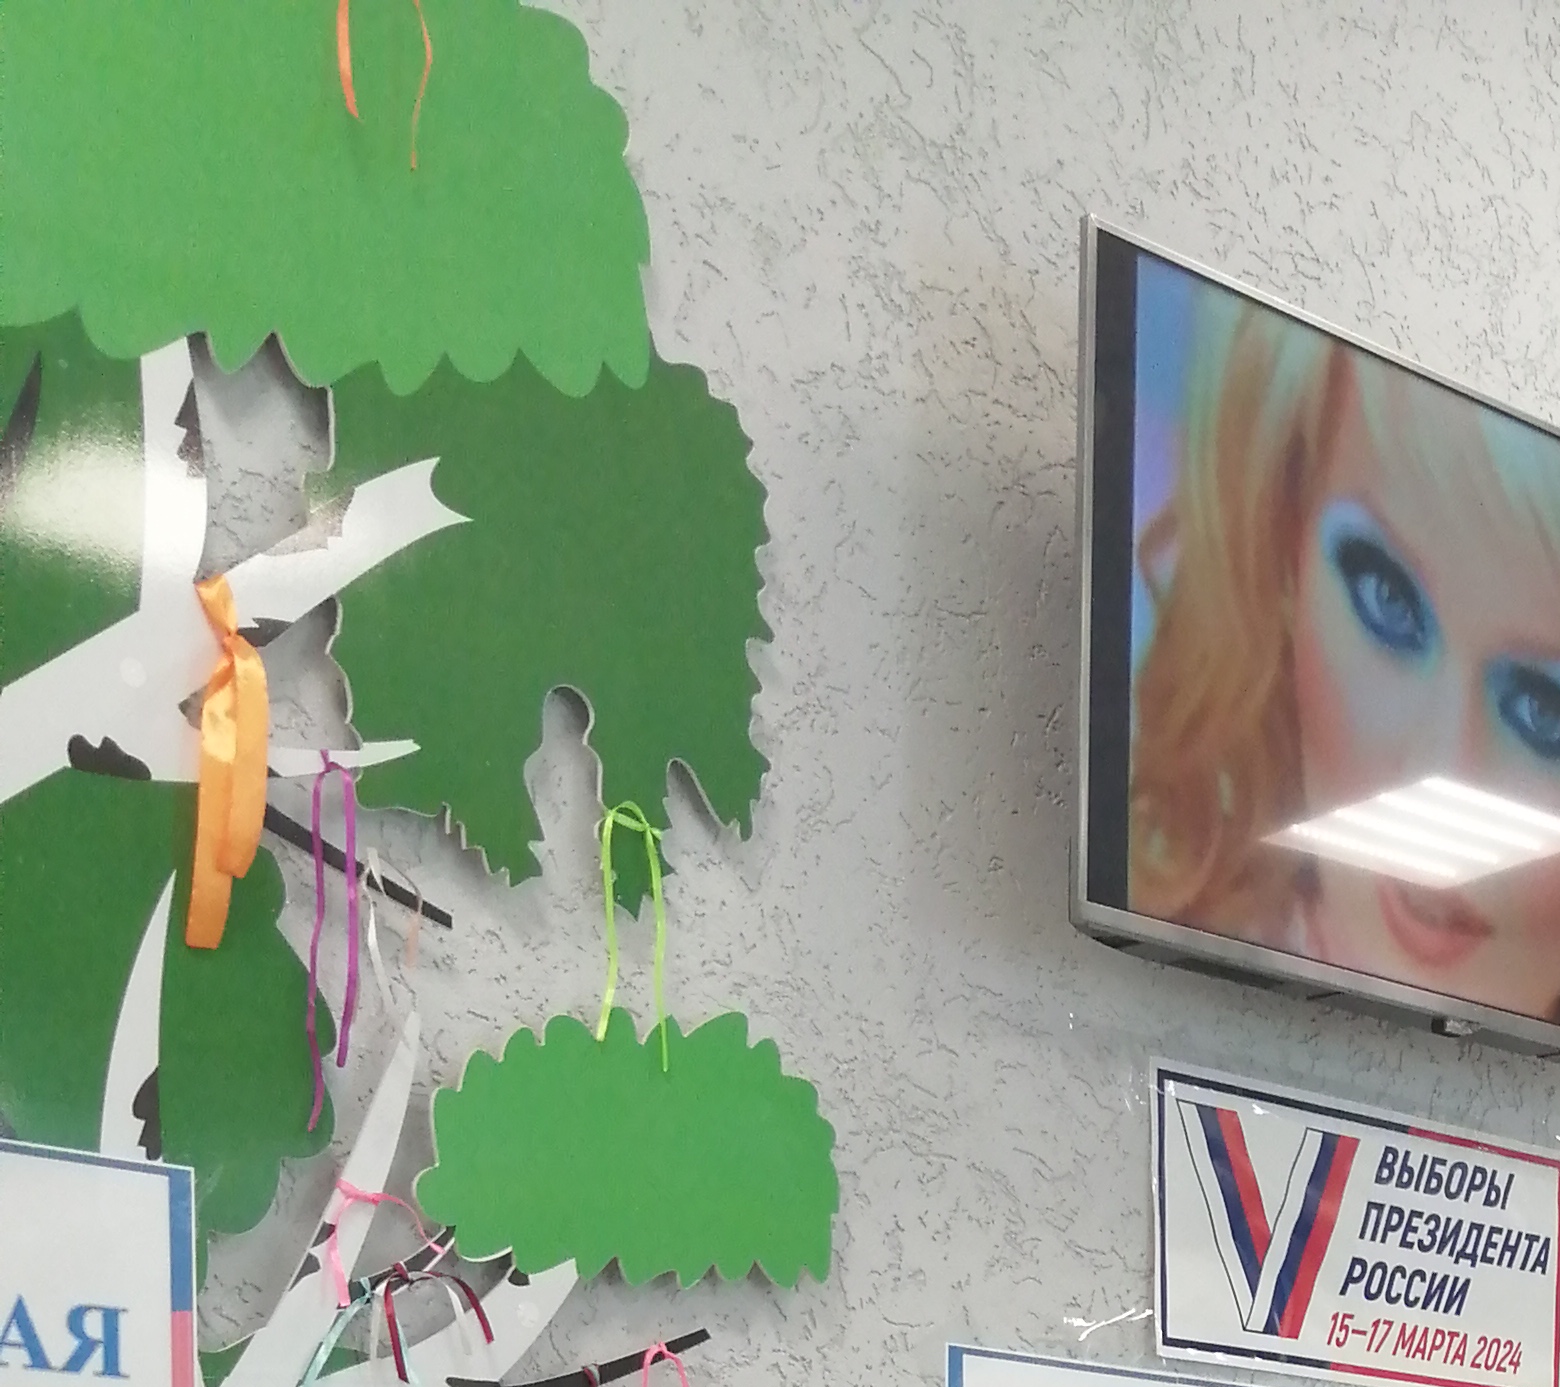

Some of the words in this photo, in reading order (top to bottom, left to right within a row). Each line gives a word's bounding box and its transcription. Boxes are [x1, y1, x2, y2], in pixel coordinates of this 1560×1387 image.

[1374, 1145, 1515, 1210] ВЫБОРЫ
[1358, 1201, 1552, 1275] ПРЕЗИДЕНТА
[1339, 1257, 1471, 1317] РОССИИ
[1392, 1331, 1467, 1368] МАРТА
[1470, 1336, 1523, 1375] 2024
